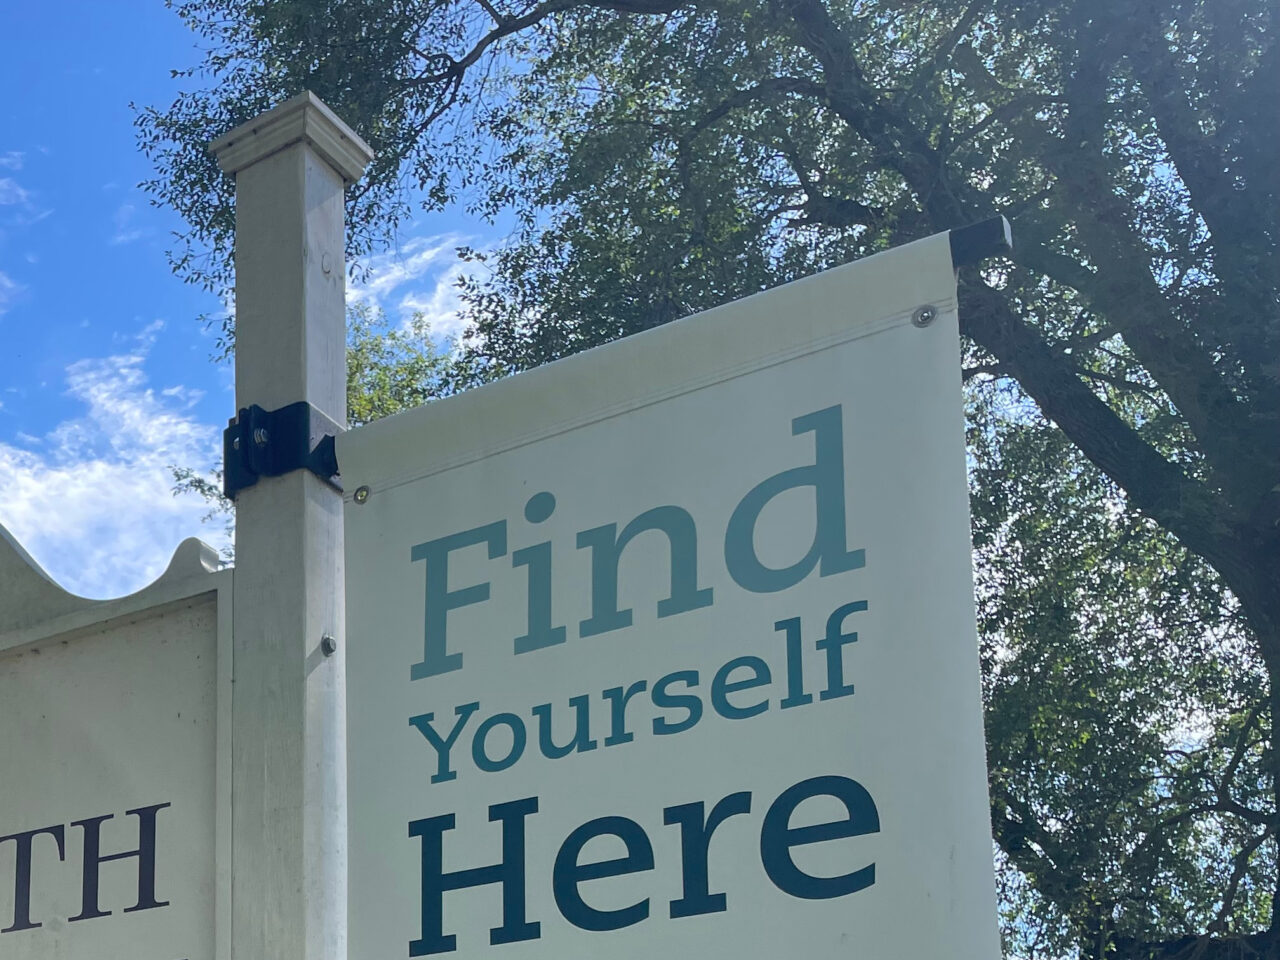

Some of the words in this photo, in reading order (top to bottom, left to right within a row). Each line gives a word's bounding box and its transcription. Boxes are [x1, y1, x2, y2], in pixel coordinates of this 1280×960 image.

[410, 404, 866, 681] Find
[408, 599, 868, 784] Yourself
[408, 775, 881, 957] Here
